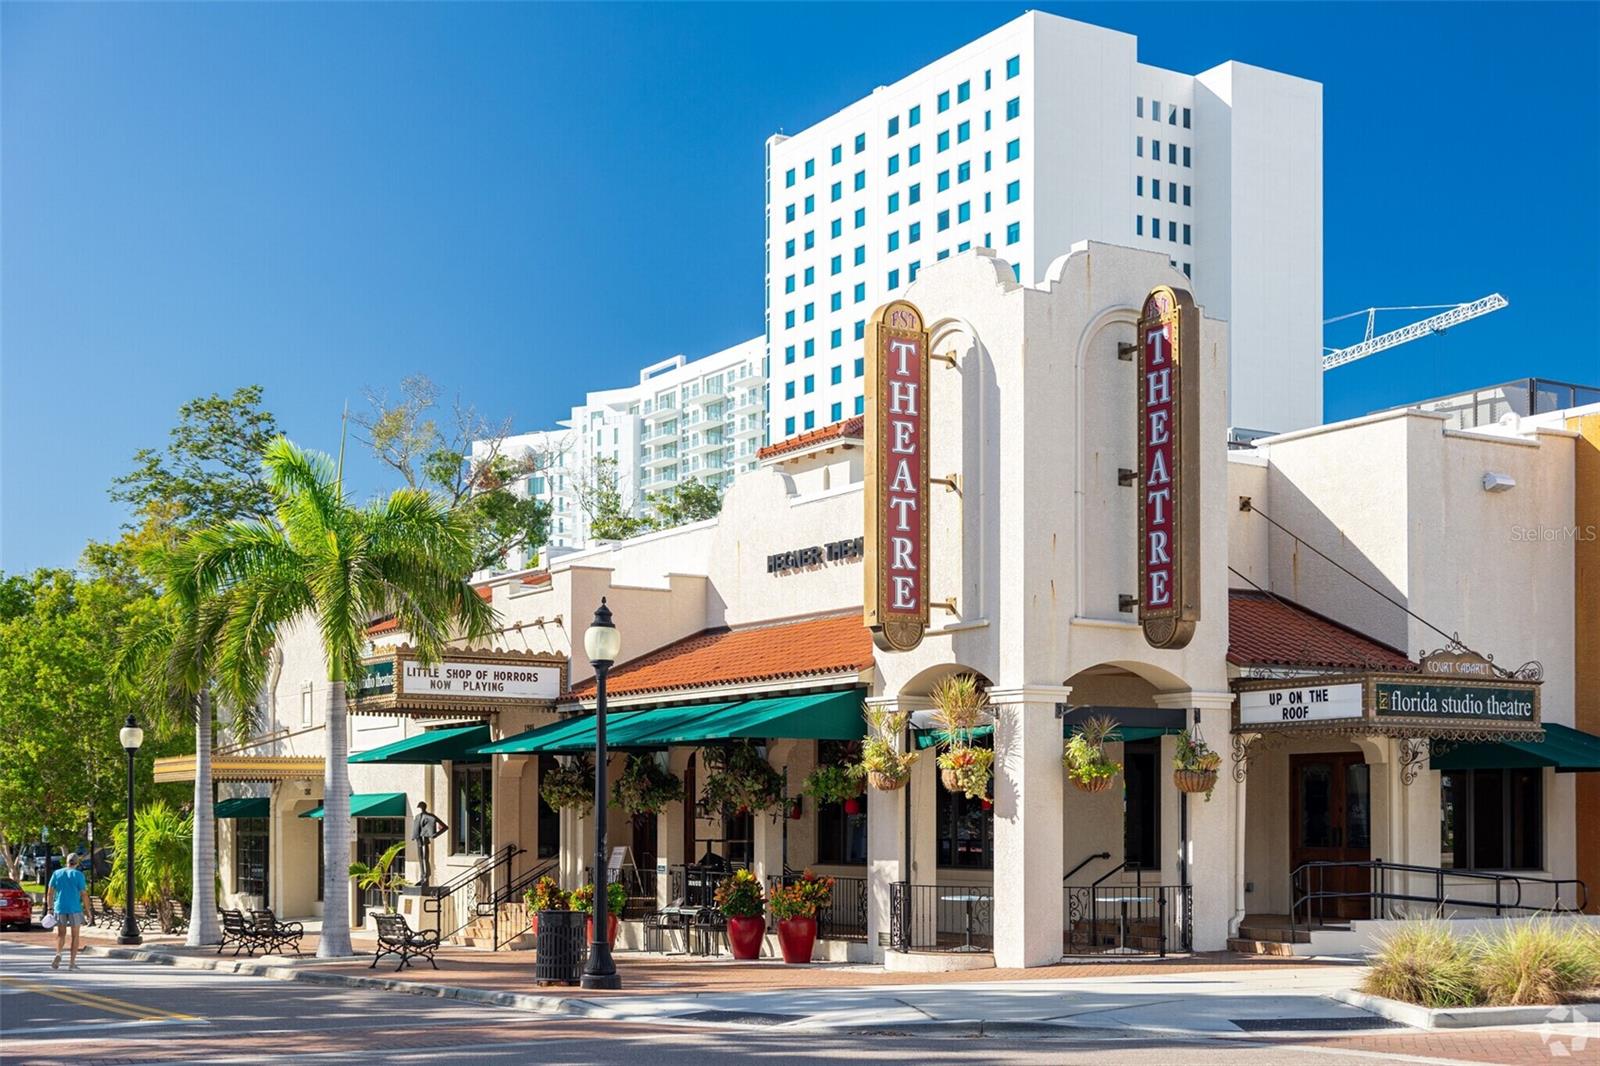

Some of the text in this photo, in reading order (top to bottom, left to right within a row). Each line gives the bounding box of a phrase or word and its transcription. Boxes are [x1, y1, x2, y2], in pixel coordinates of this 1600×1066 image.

[891, 310, 916, 330] FST
[889, 340, 918, 611] THEATRE
[1146, 328, 1171, 605] THEATRE
[767, 546, 824, 573] HEGNER
[406, 666, 539, 683] LITTLE SHOP OF HORRORS
[1427, 661, 1490, 675] COURT CABARET
[430, 680, 505, 692] NOW PLAYING
[1269, 689, 1329, 706] UP ON THE
[1391, 690, 1532, 717] florida studio theatre
[1282, 706, 1309, 720] ROOF
